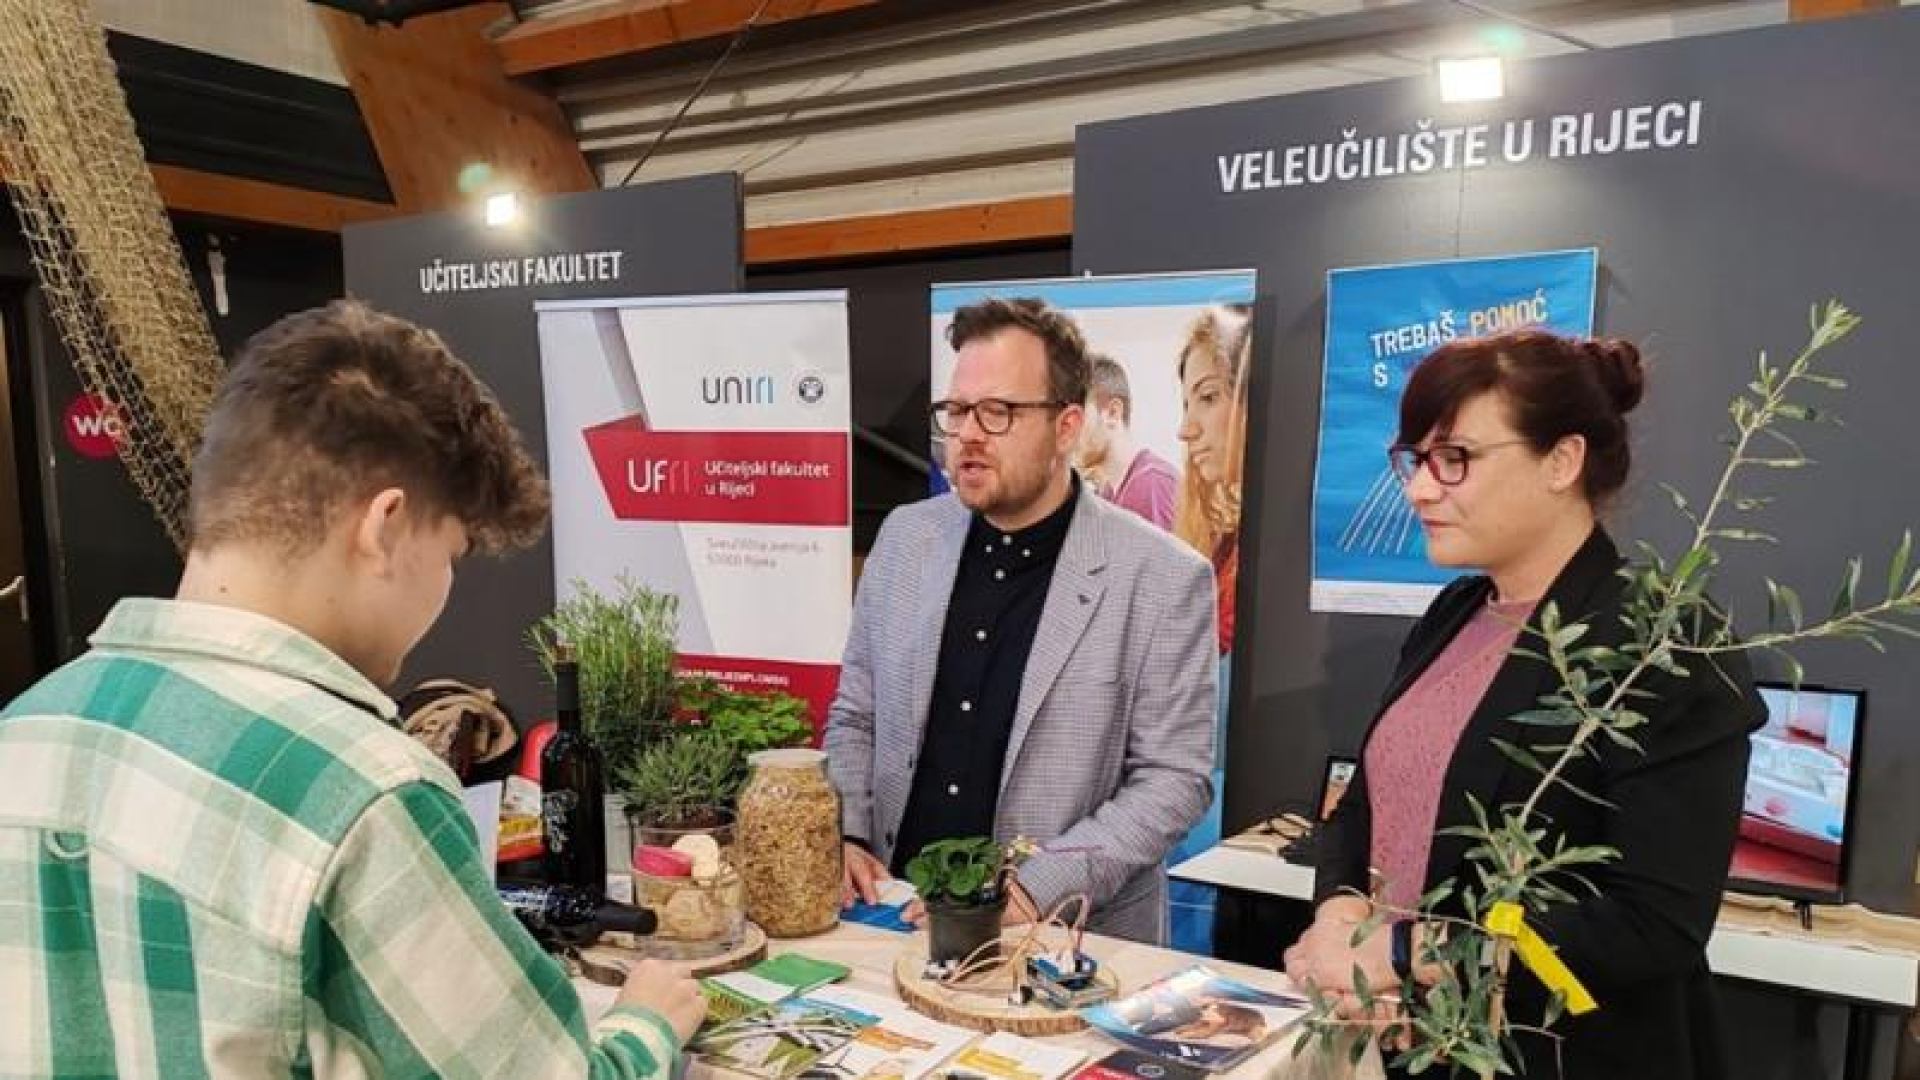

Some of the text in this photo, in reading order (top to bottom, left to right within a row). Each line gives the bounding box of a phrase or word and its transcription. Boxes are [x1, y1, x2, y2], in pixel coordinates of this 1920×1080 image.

[1218, 100, 1702, 193] VELEUČILIŠTE U RIJECI
[419, 251, 623, 293] UČITELJSKI FAKULTET
[1371, 287, 1549, 357] TREBAŠ POMOĆ
[1373, 363, 1389, 387] S
[705, 460, 830, 479] Učiteljski fakultet
[705, 480, 755, 500] u Rijeci
